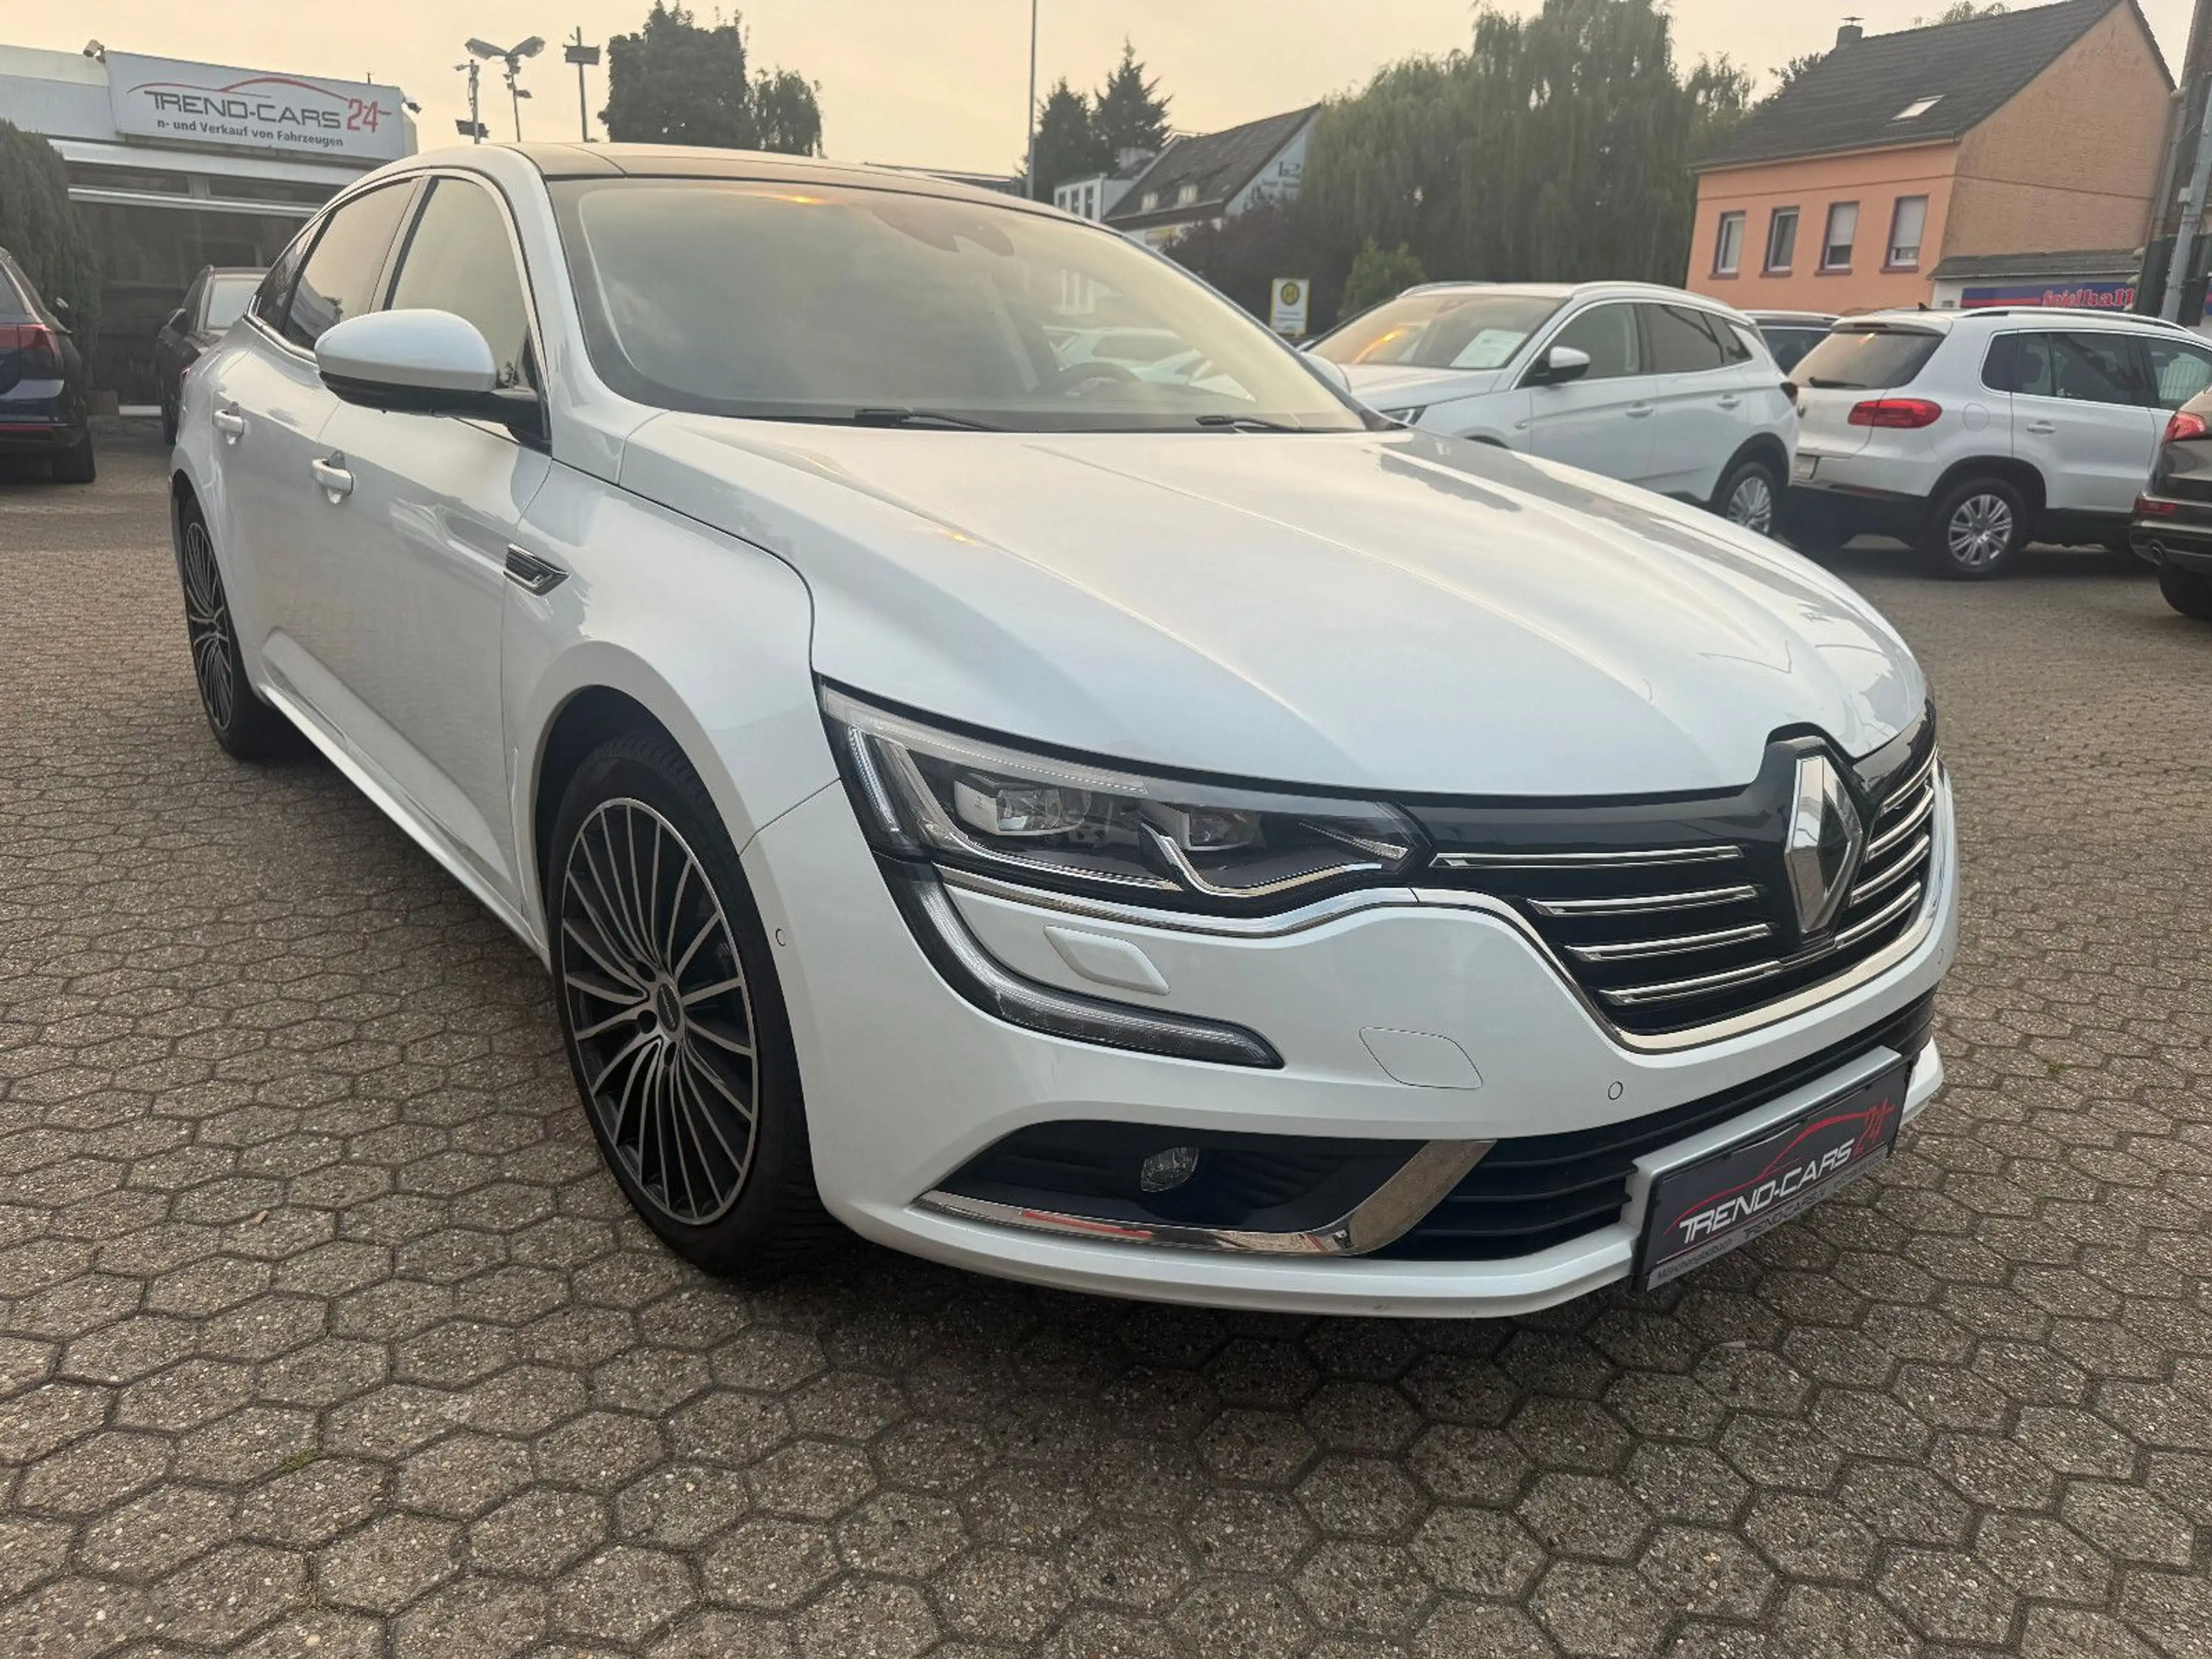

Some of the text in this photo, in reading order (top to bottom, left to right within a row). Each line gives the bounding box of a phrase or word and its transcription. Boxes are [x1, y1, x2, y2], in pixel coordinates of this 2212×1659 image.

[144, 90, 378, 132] TREND-CARS 24
[173, 120, 196, 131] und
[201, 123, 248, 138] Verkauf
[252, 129, 274, 140] von
[277, 131, 343, 147] Fahrzeugen
[1679, 1138, 1855, 1244] TREND-CARS
